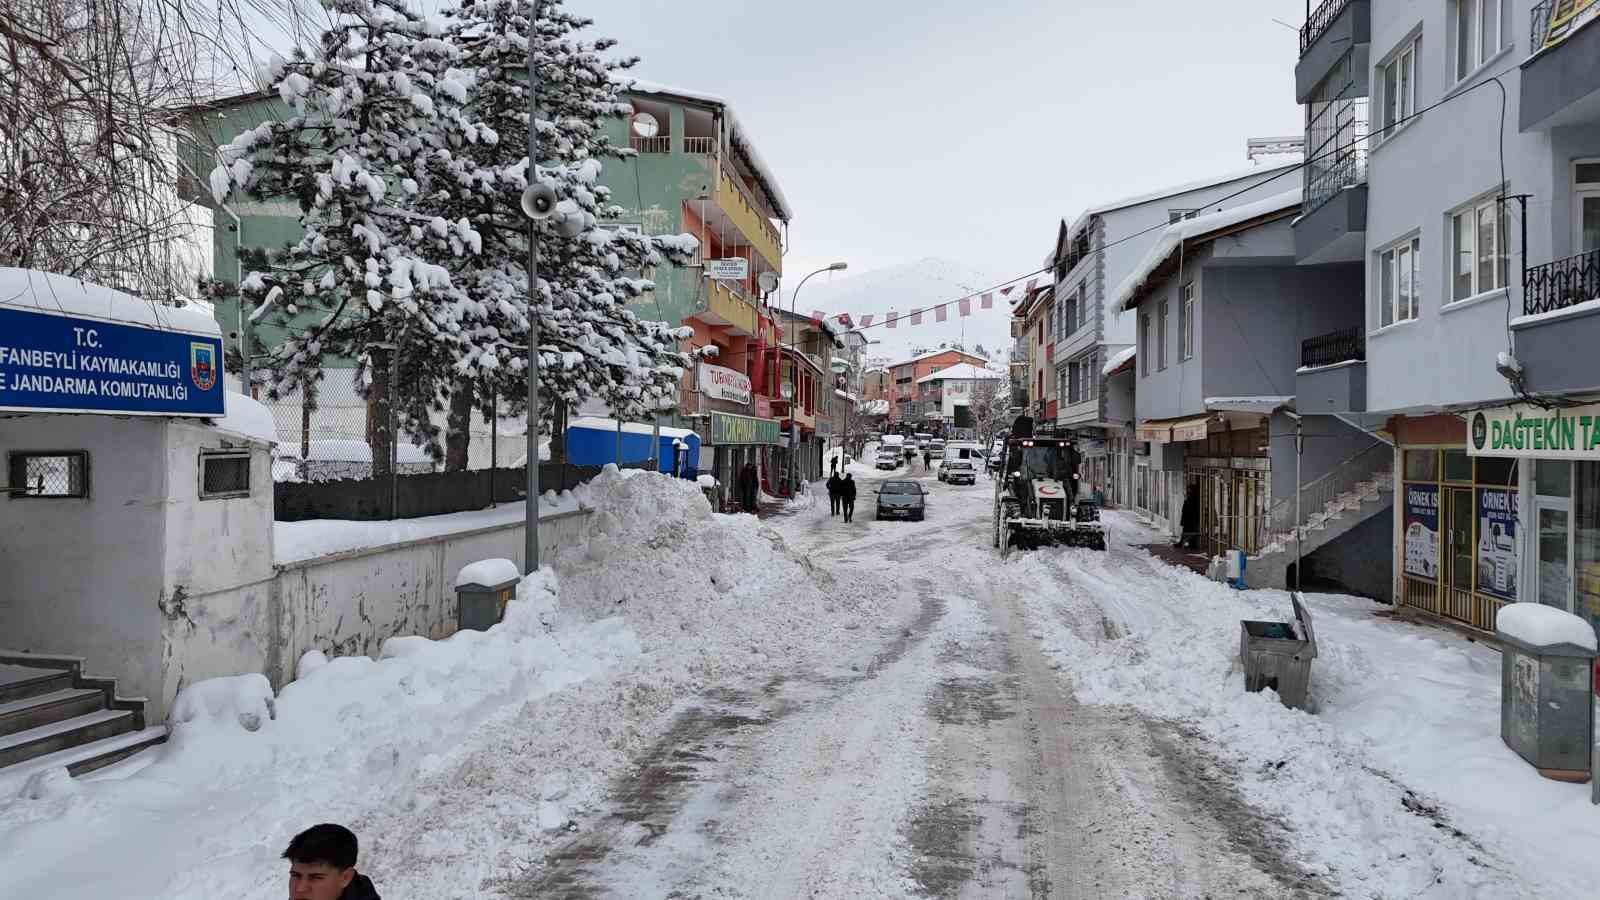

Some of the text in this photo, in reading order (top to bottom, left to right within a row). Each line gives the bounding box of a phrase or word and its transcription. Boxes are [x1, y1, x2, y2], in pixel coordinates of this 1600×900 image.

[73, 328, 103, 348] T.C.
[0, 347, 180, 378] FANBEYLİ KAYMAKAMLIĞI
[11, 374, 97, 396] JANDARMA
[101, 381, 188, 401] KOMUTANLIĞI
[1491, 409, 1575, 450] DAĞTEKİN
[1483, 489, 1511, 512] ÖRNEK
